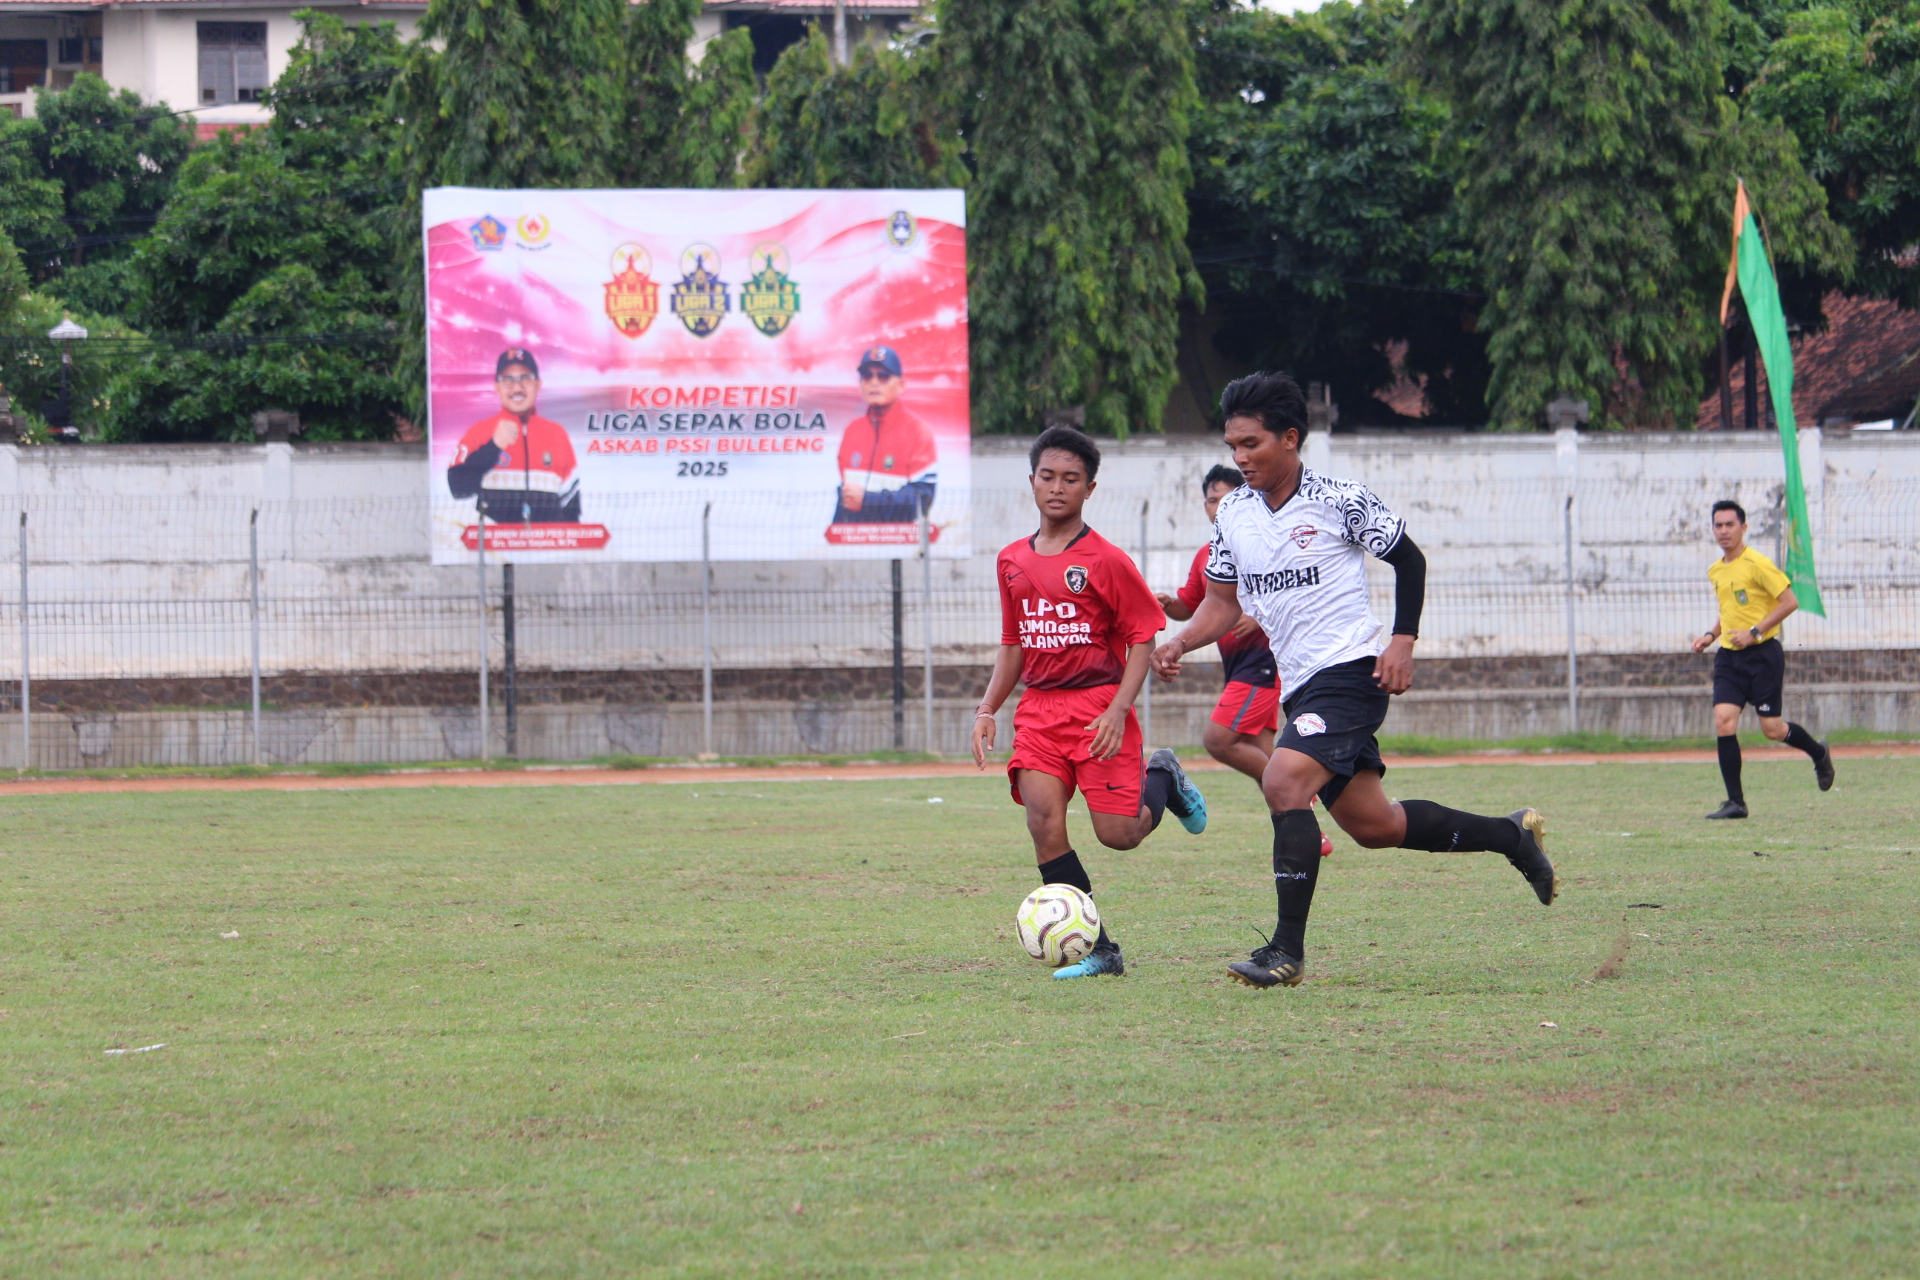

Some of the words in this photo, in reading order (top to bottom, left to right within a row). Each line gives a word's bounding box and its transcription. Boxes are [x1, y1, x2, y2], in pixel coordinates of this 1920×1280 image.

[676, 295, 711, 310] LIGA
[714, 295, 726, 310] 2
[746, 295, 780, 310] LIGA
[783, 295, 795, 310] 3
[630, 386, 798, 408] KOMPETISI
[587, 413, 648, 432] LIGA
[657, 413, 747, 431] SEPAK
[754, 412, 827, 430] BOLA
[587, 439, 659, 454] ASKAB
[666, 439, 711, 453] PSSI
[716, 437, 825, 453] BULELENG
[676, 461, 729, 477] 2025
